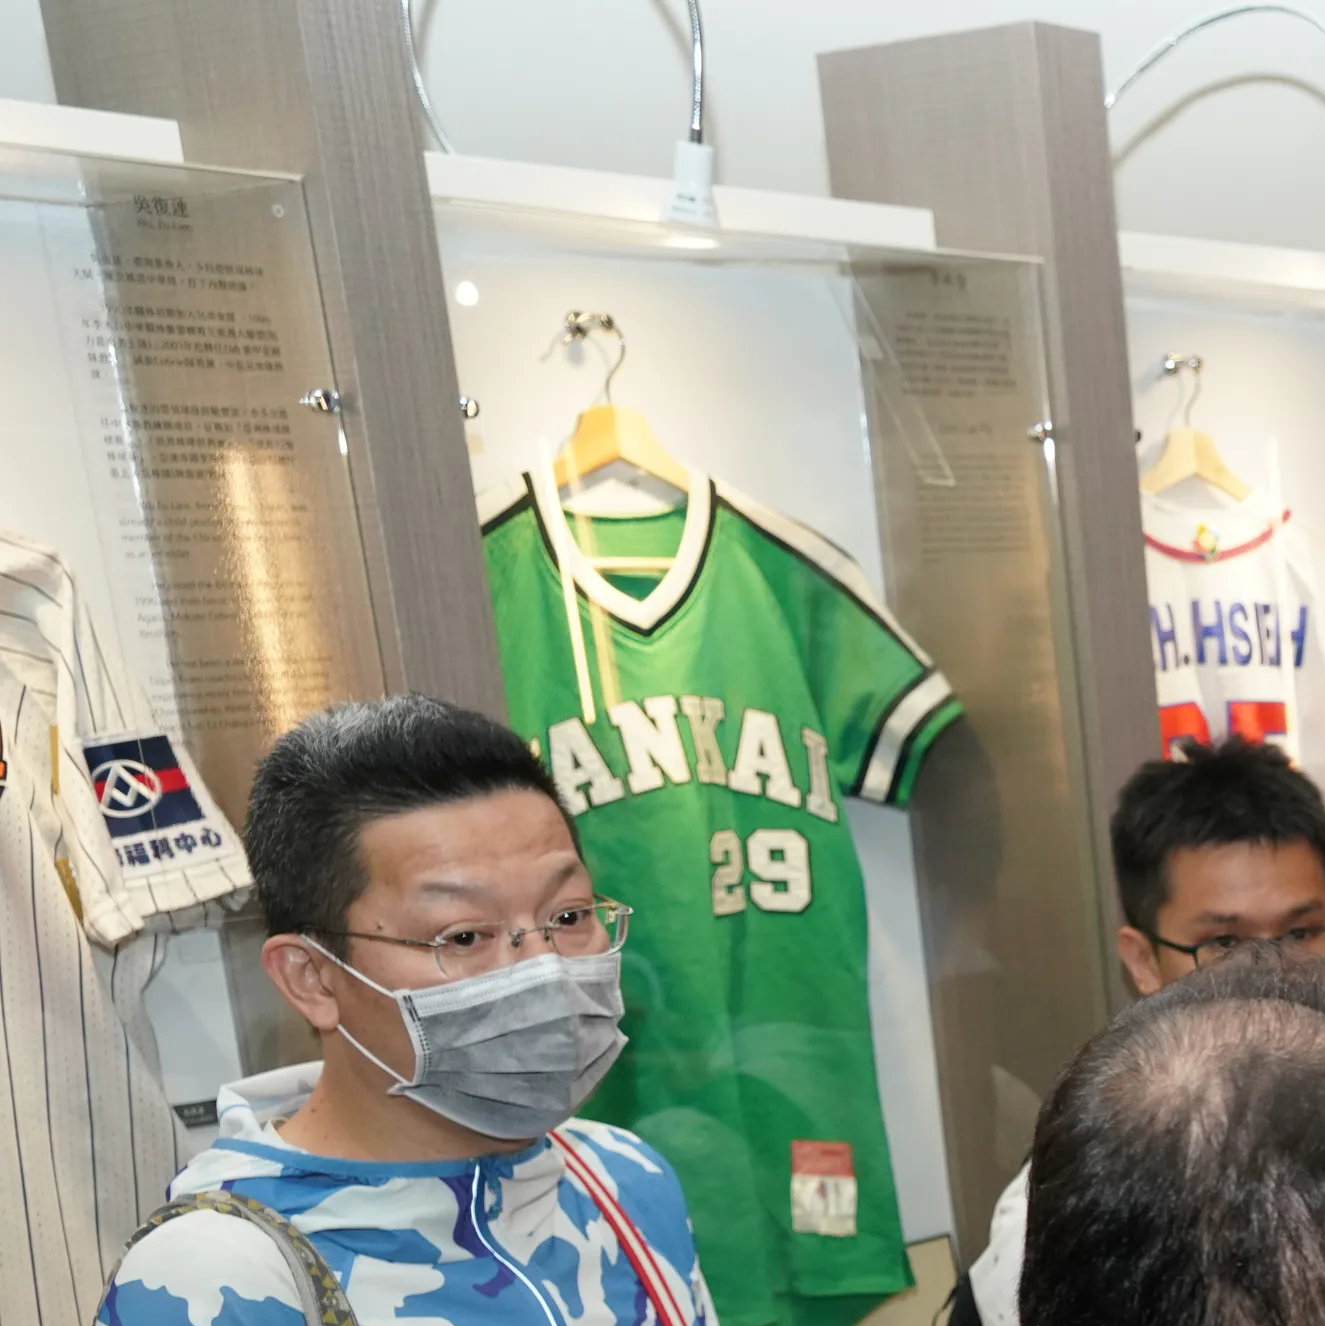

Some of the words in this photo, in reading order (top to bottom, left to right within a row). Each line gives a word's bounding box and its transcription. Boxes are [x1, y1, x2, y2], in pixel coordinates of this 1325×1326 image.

[534, 694, 839, 824] ANKAI
[114, 827, 222, 867] 福利中心
[709, 828, 812, 917] 29
